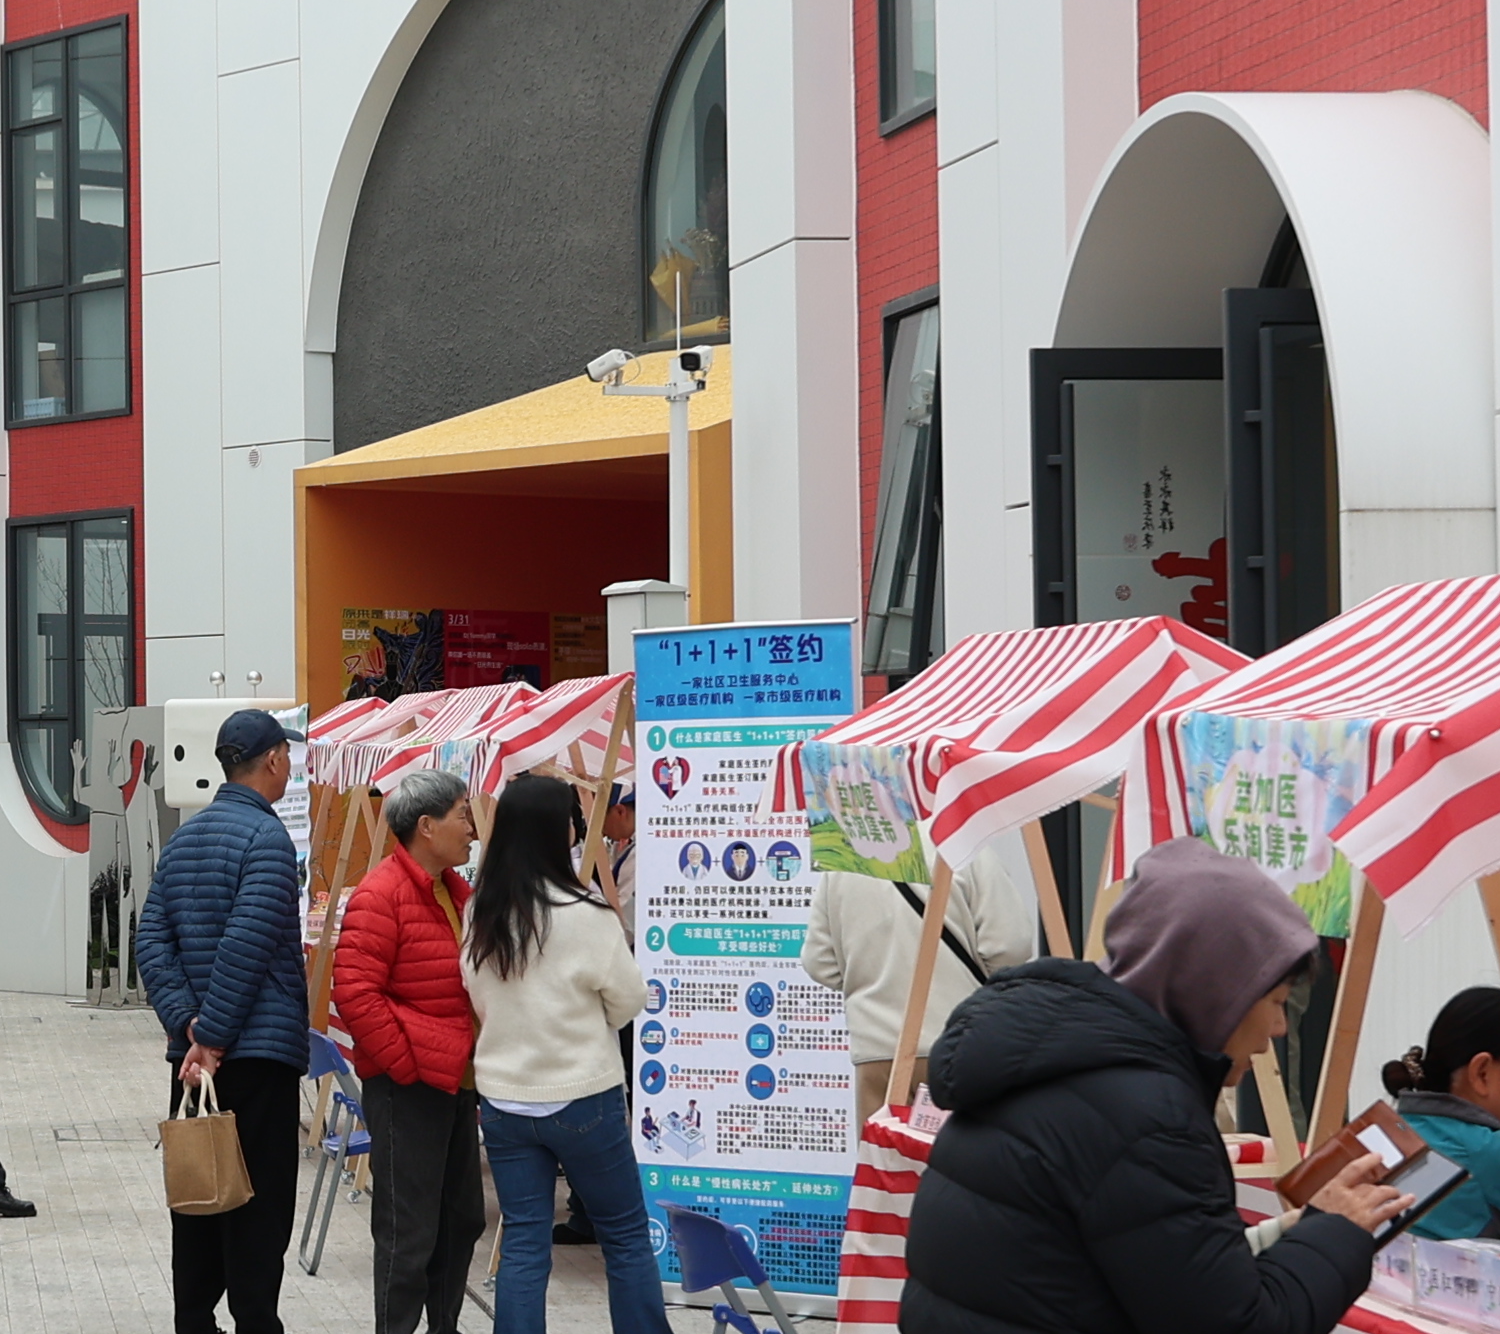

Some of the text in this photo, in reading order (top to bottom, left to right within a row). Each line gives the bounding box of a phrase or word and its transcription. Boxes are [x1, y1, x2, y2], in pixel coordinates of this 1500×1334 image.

[681, 673, 799, 688] 一家社区卫生服务中心
[645, 689, 841, 707] 一家区级医疗机构 一家市级医疗机构
[1233, 771, 1297, 819] 益加医
[1222, 823, 1310, 872] 乐淘集市
